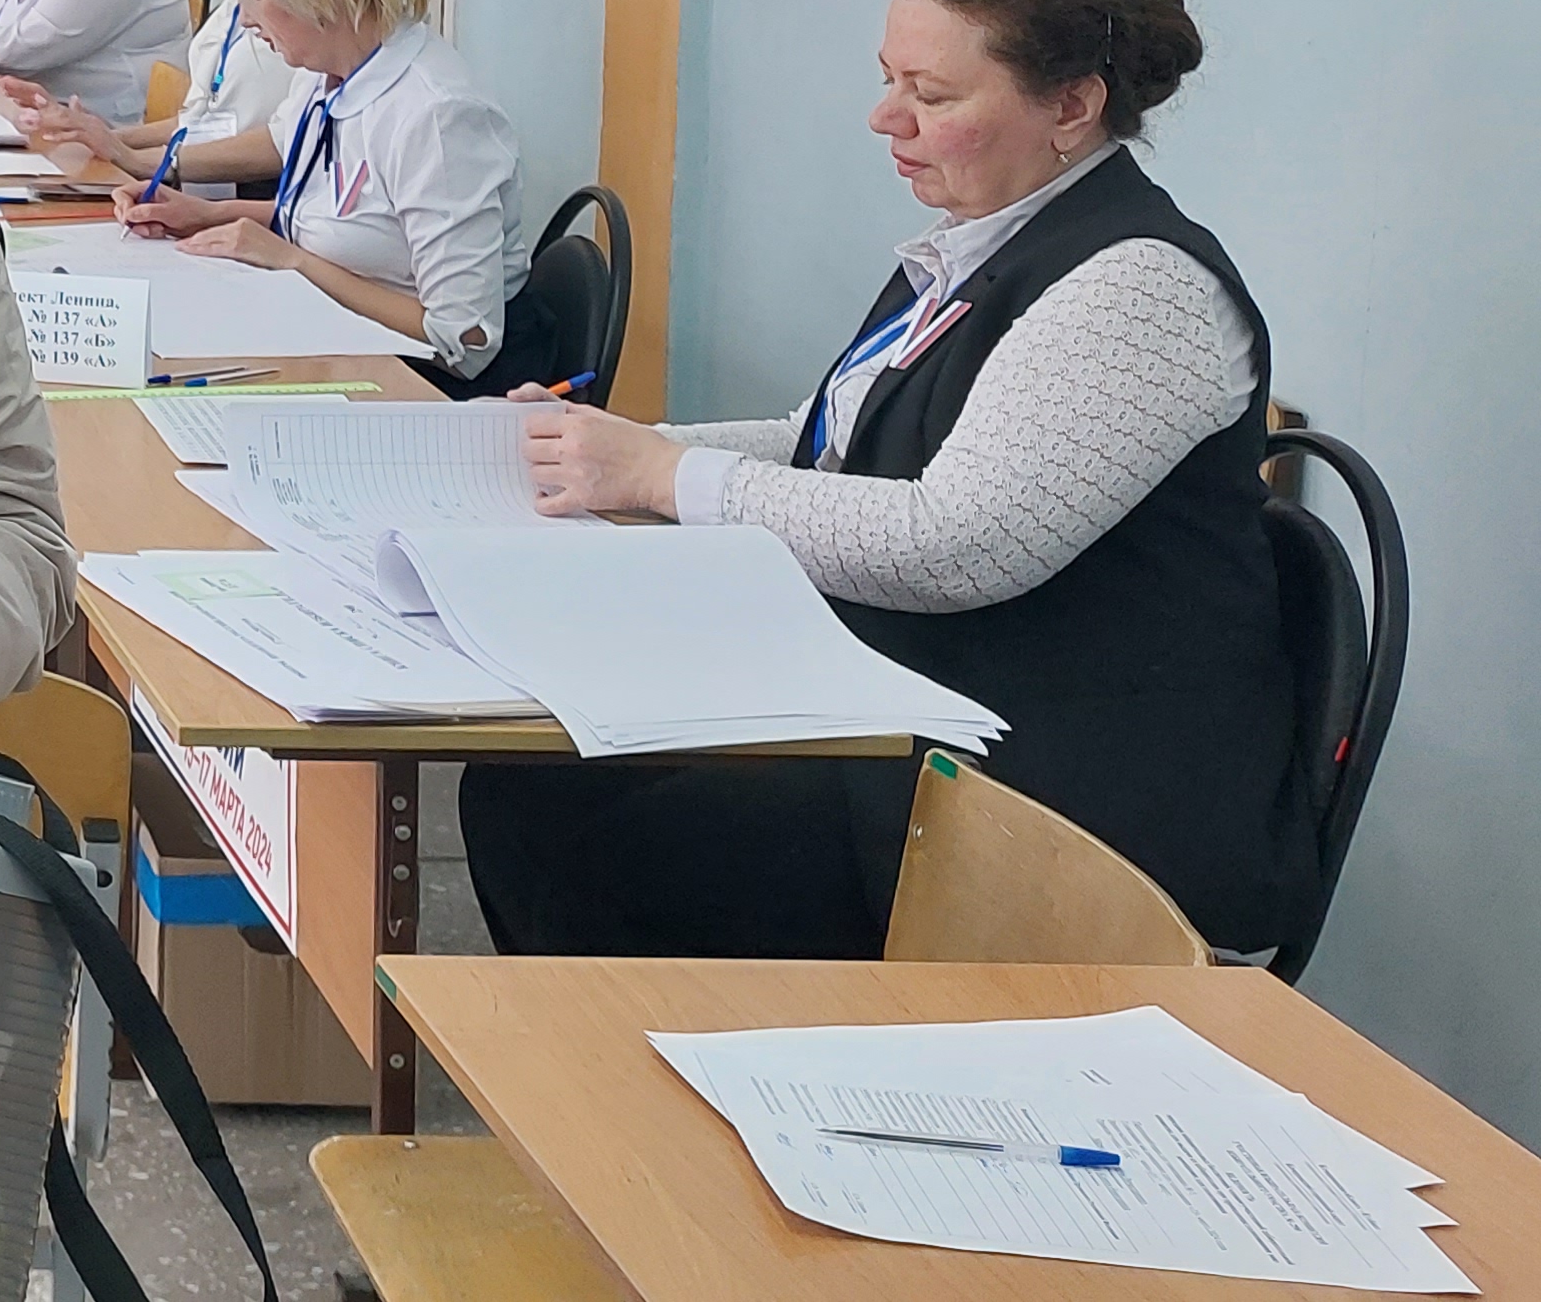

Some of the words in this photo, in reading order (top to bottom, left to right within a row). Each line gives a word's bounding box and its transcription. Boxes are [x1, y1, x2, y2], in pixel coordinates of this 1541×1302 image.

[18, 292, 47, 304] ект
[50, 291, 120, 310] Ленина,
[28, 309, 47, 323] №
[54, 311, 80, 326] 137
[85, 314, 118, 328] «А»
[28, 329, 46, 343] №
[53, 331, 79, 346] 137
[84, 333, 116, 347] «Б»
[31, 349, 46, 363] №
[53, 351, 79, 365] 139
[84, 354, 117, 367] «А»
[209, 765, 245, 841] МАРТА
[245, 814, 273, 880] 2024
